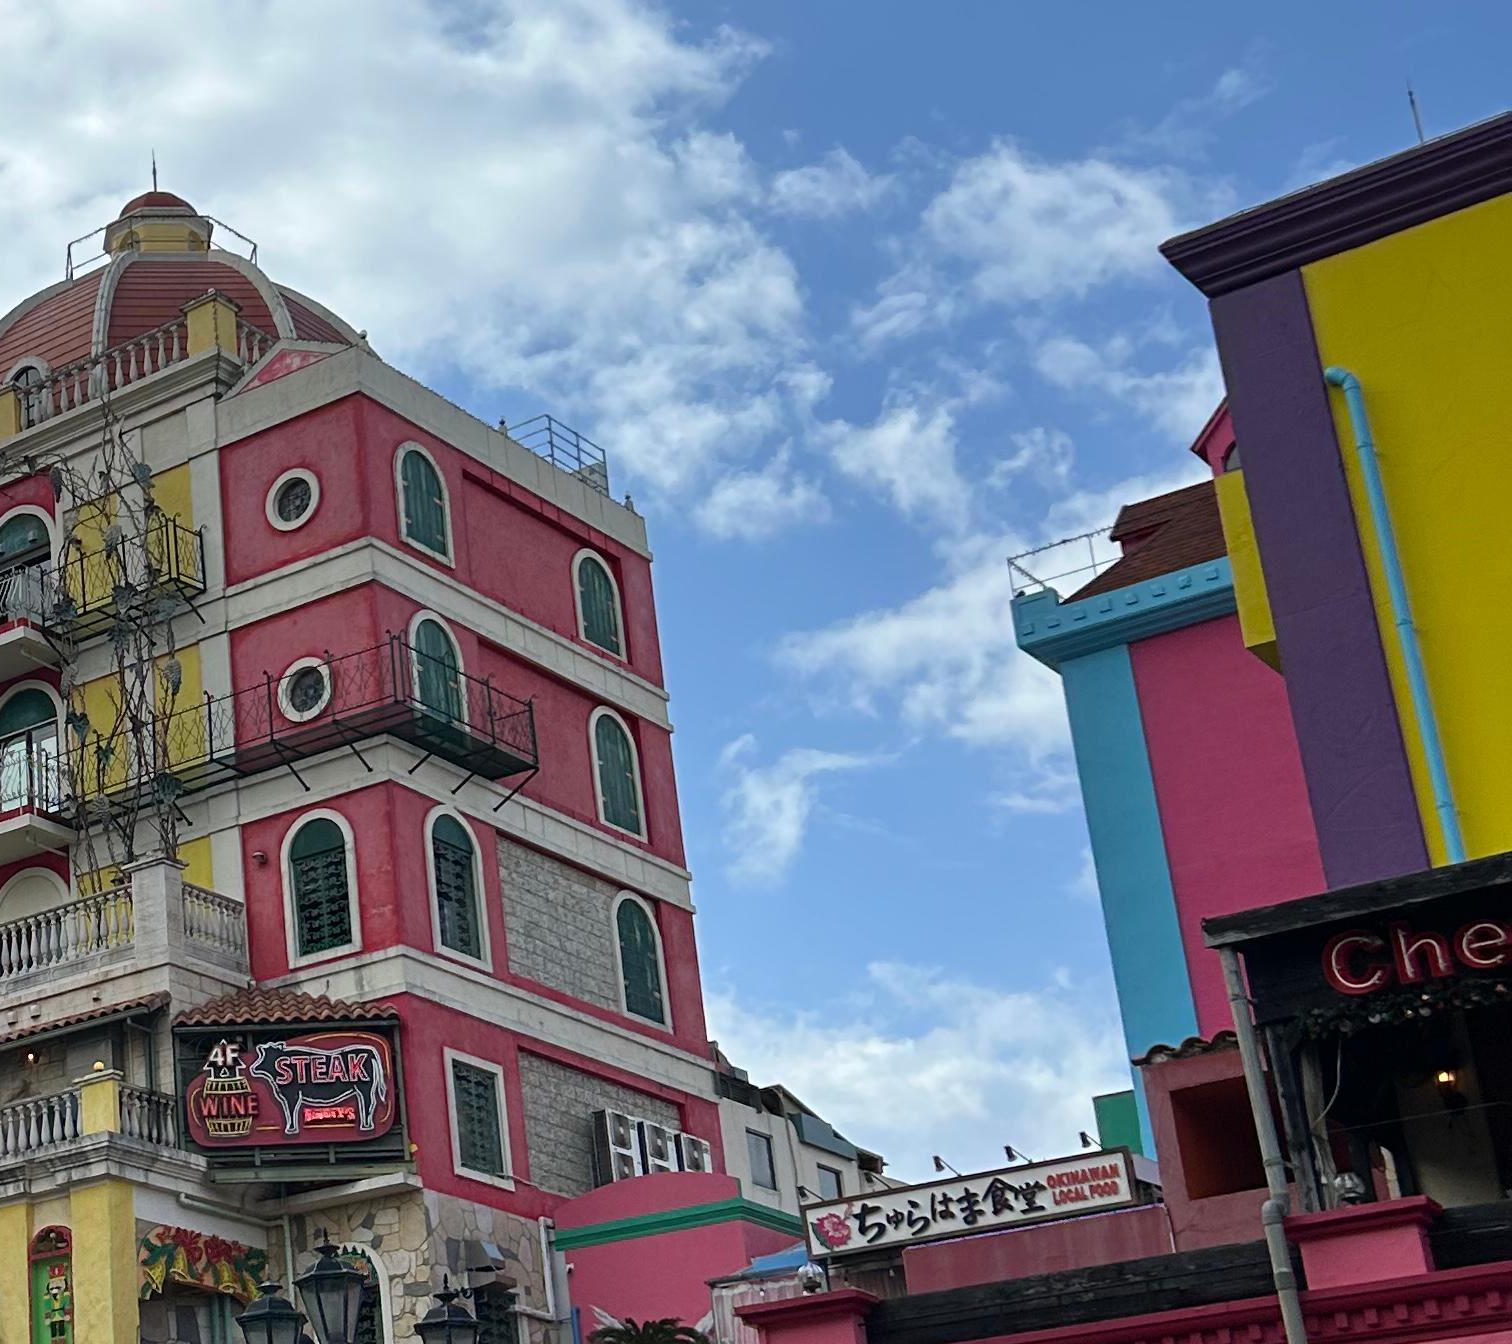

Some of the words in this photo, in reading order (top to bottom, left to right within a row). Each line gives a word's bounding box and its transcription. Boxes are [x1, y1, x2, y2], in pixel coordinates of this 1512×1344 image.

[209, 1045, 240, 1066] 4F
[274, 1054, 371, 1085] STEAK
[200, 1094, 260, 1117] WINE
[1046, 1163, 1120, 1190] OKINAWAN
[1051, 1188, 1088, 1206] LOCAL
[1090, 1180, 1120, 1200] FOOD
[852, 1177, 1048, 1244] ちゅらはま食堂
